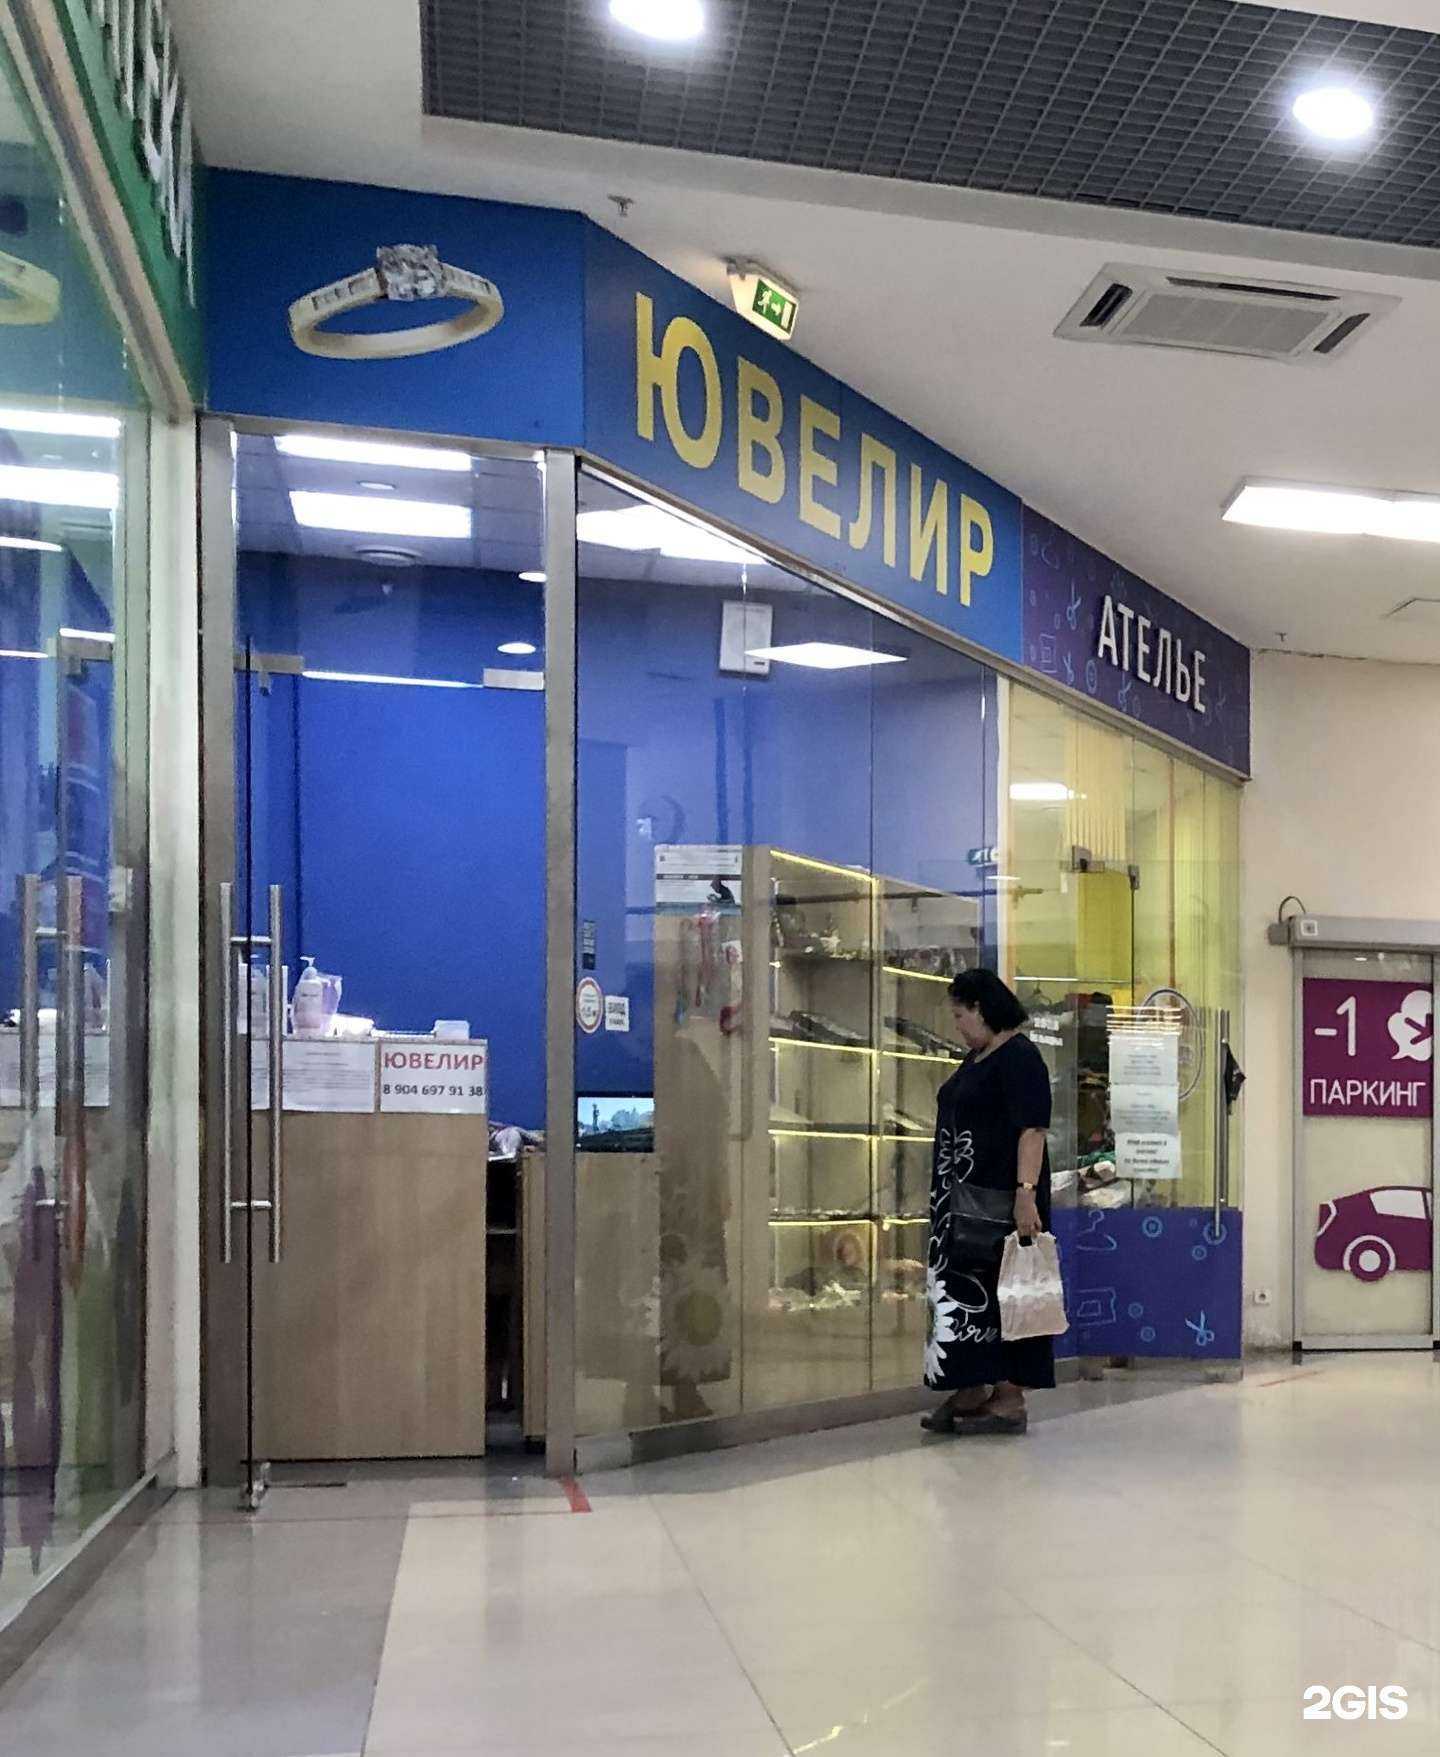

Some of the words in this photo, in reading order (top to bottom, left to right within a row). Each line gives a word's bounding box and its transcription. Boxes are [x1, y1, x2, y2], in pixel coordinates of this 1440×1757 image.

[635, 292, 994, 607] ЮВЕЛИР
[1097, 595, 1207, 713] АТЕЛЬЕ
[1314, 995, 1357, 1057] -1
[384, 1051, 484, 1070] ЮВЕЛИР
[383, 1084, 391, 1095] 8
[394, 1084, 418, 1096] 904
[421, 1085, 445, 1096] 697
[449, 1085, 464, 1096] 91
[468, 1086, 484, 1097] 38
[1310, 1078, 1427, 1107] ПАРКИНГ
